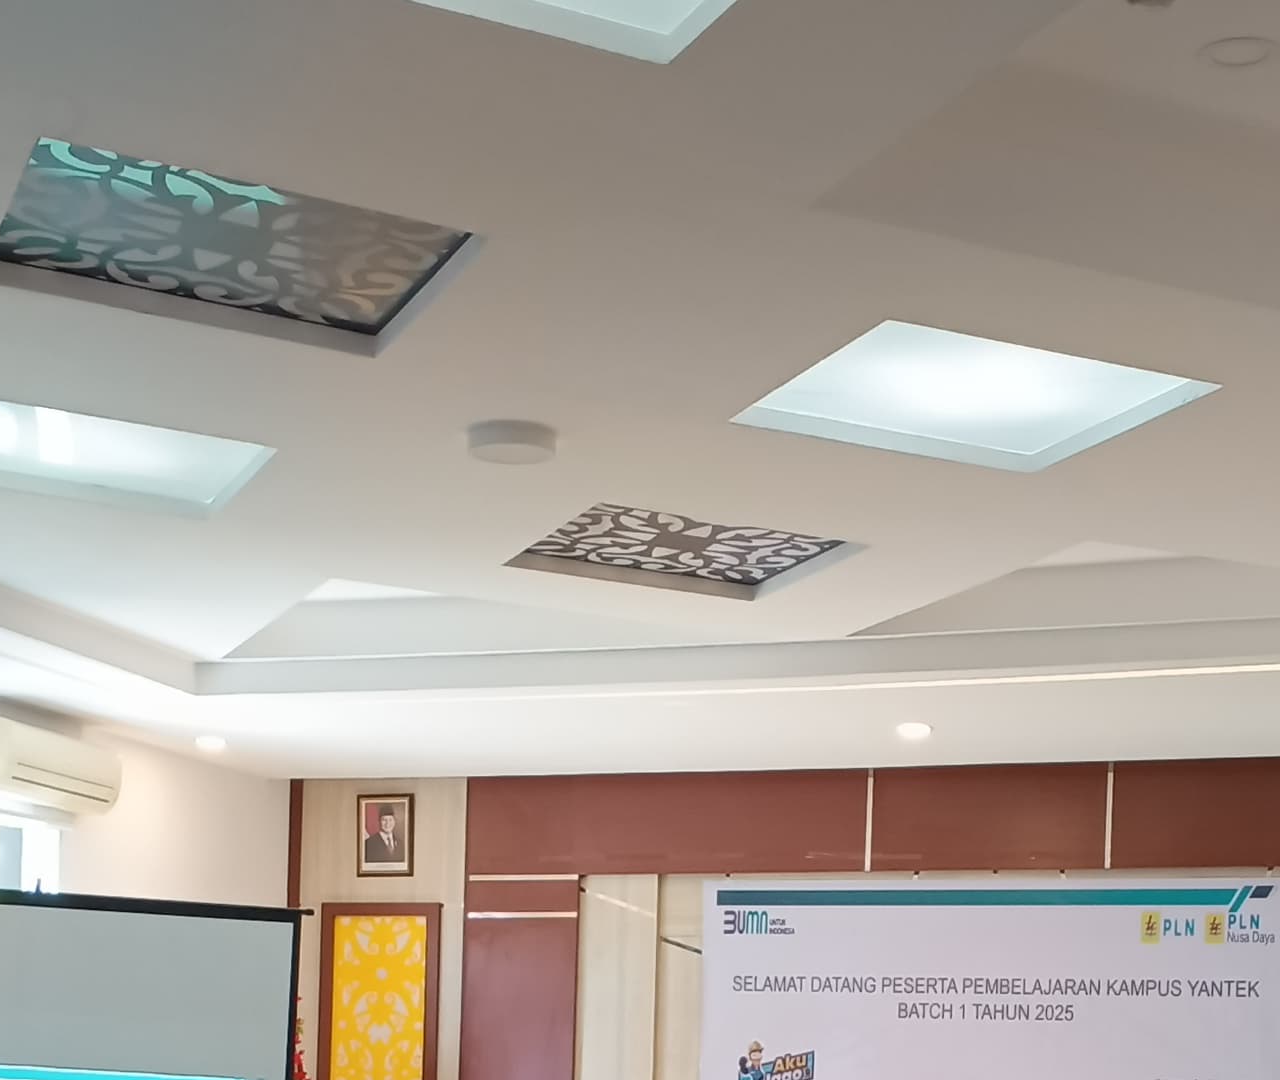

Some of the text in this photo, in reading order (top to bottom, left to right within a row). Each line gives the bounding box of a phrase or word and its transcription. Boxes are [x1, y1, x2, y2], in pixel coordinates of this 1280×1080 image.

[1163, 918, 1195, 936] PLN
[1228, 914, 1260, 929] PLN
[1227, 931, 1275, 945] Nusa Daya
[732, 975, 1260, 998] SELAMAT DATANG PESERTA PEMBELAJARAN KAMPUS YANTEK
[898, 1003, 1074, 1021] BATCH 1 TAHUN 2025
[773, 1054, 807, 1073] Aku
